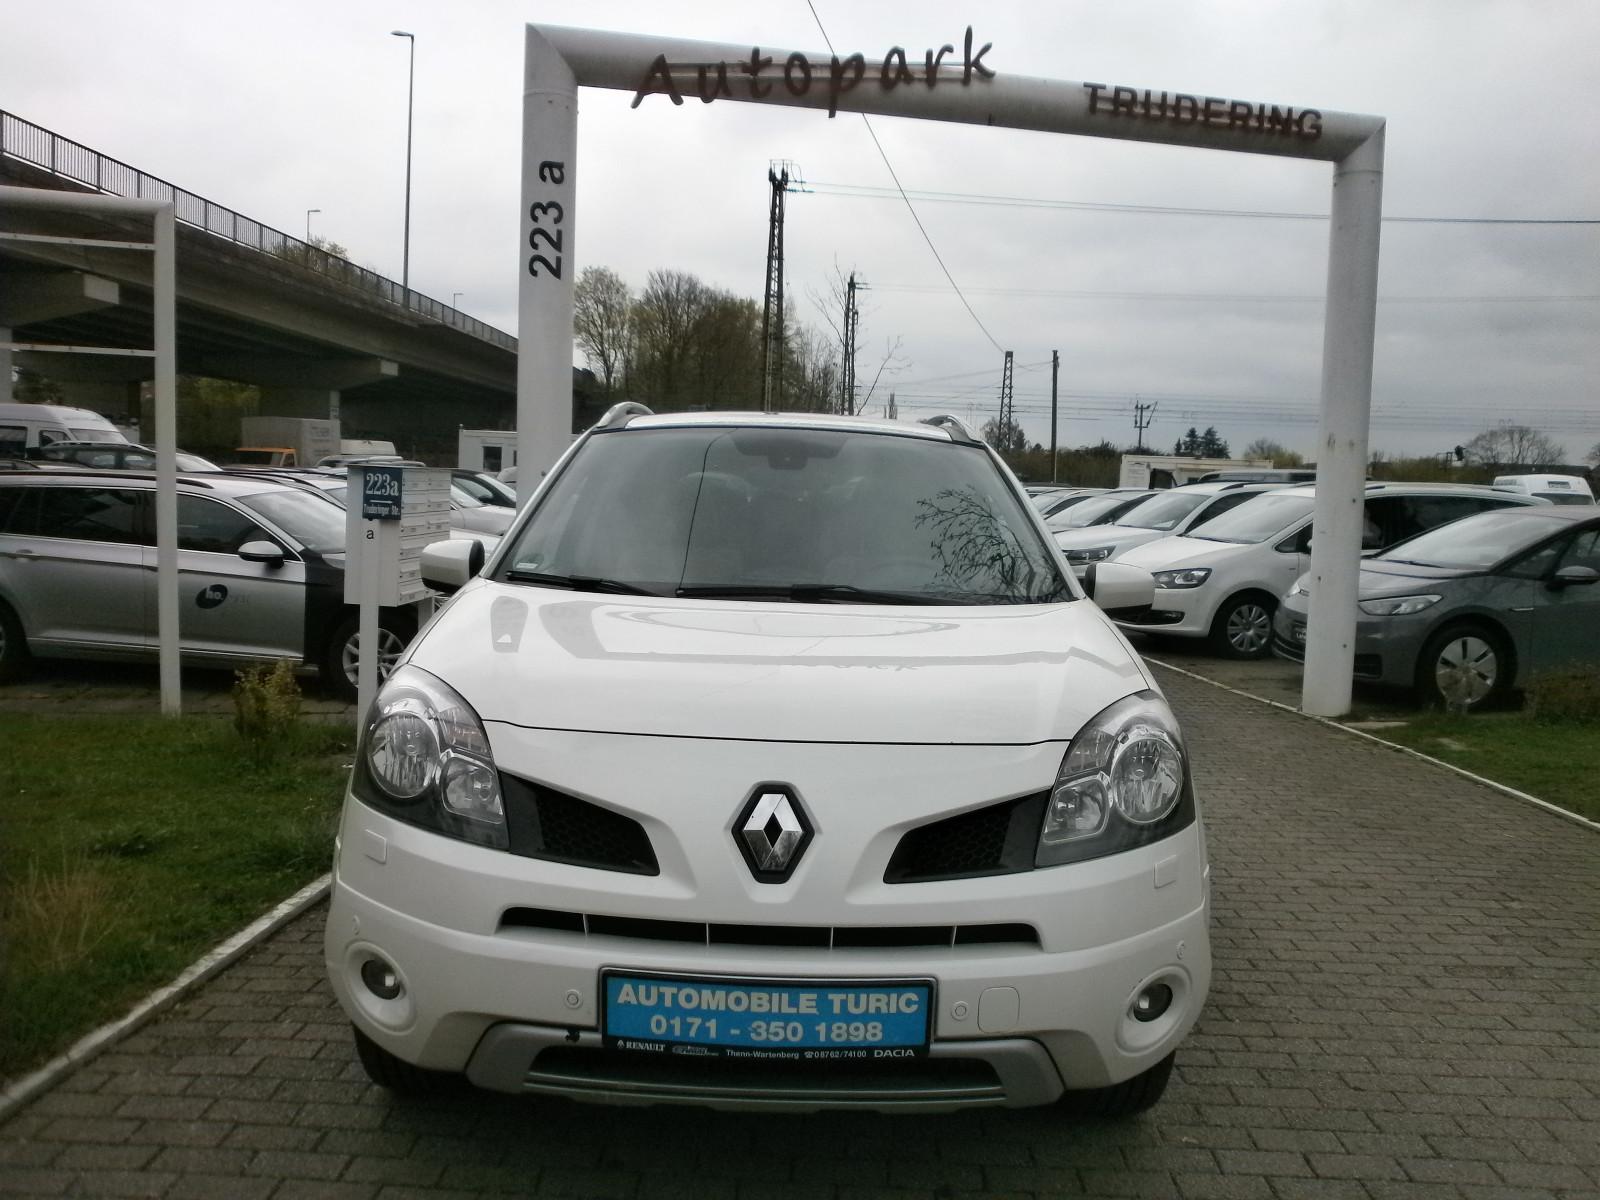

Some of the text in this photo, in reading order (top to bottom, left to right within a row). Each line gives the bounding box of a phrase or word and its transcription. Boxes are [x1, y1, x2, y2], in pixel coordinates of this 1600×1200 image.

[630, 25, 996, 119] Autopark
[1083, 82, 1323, 143] TRUDERING
[528, 160, 565, 280] 223 a
[365, 473, 400, 496] 223a
[366, 529, 375, 540] a
[617, 983, 920, 1015] AUTOMOBILE TURIC
[650, 1014, 718, 1039] 0171
[750, 1020, 804, 1042] 350
[815, 1022, 884, 1043] 1898
[625, 1041, 666, 1052] RENAULT
[874, 1049, 915, 1058] DACIA
